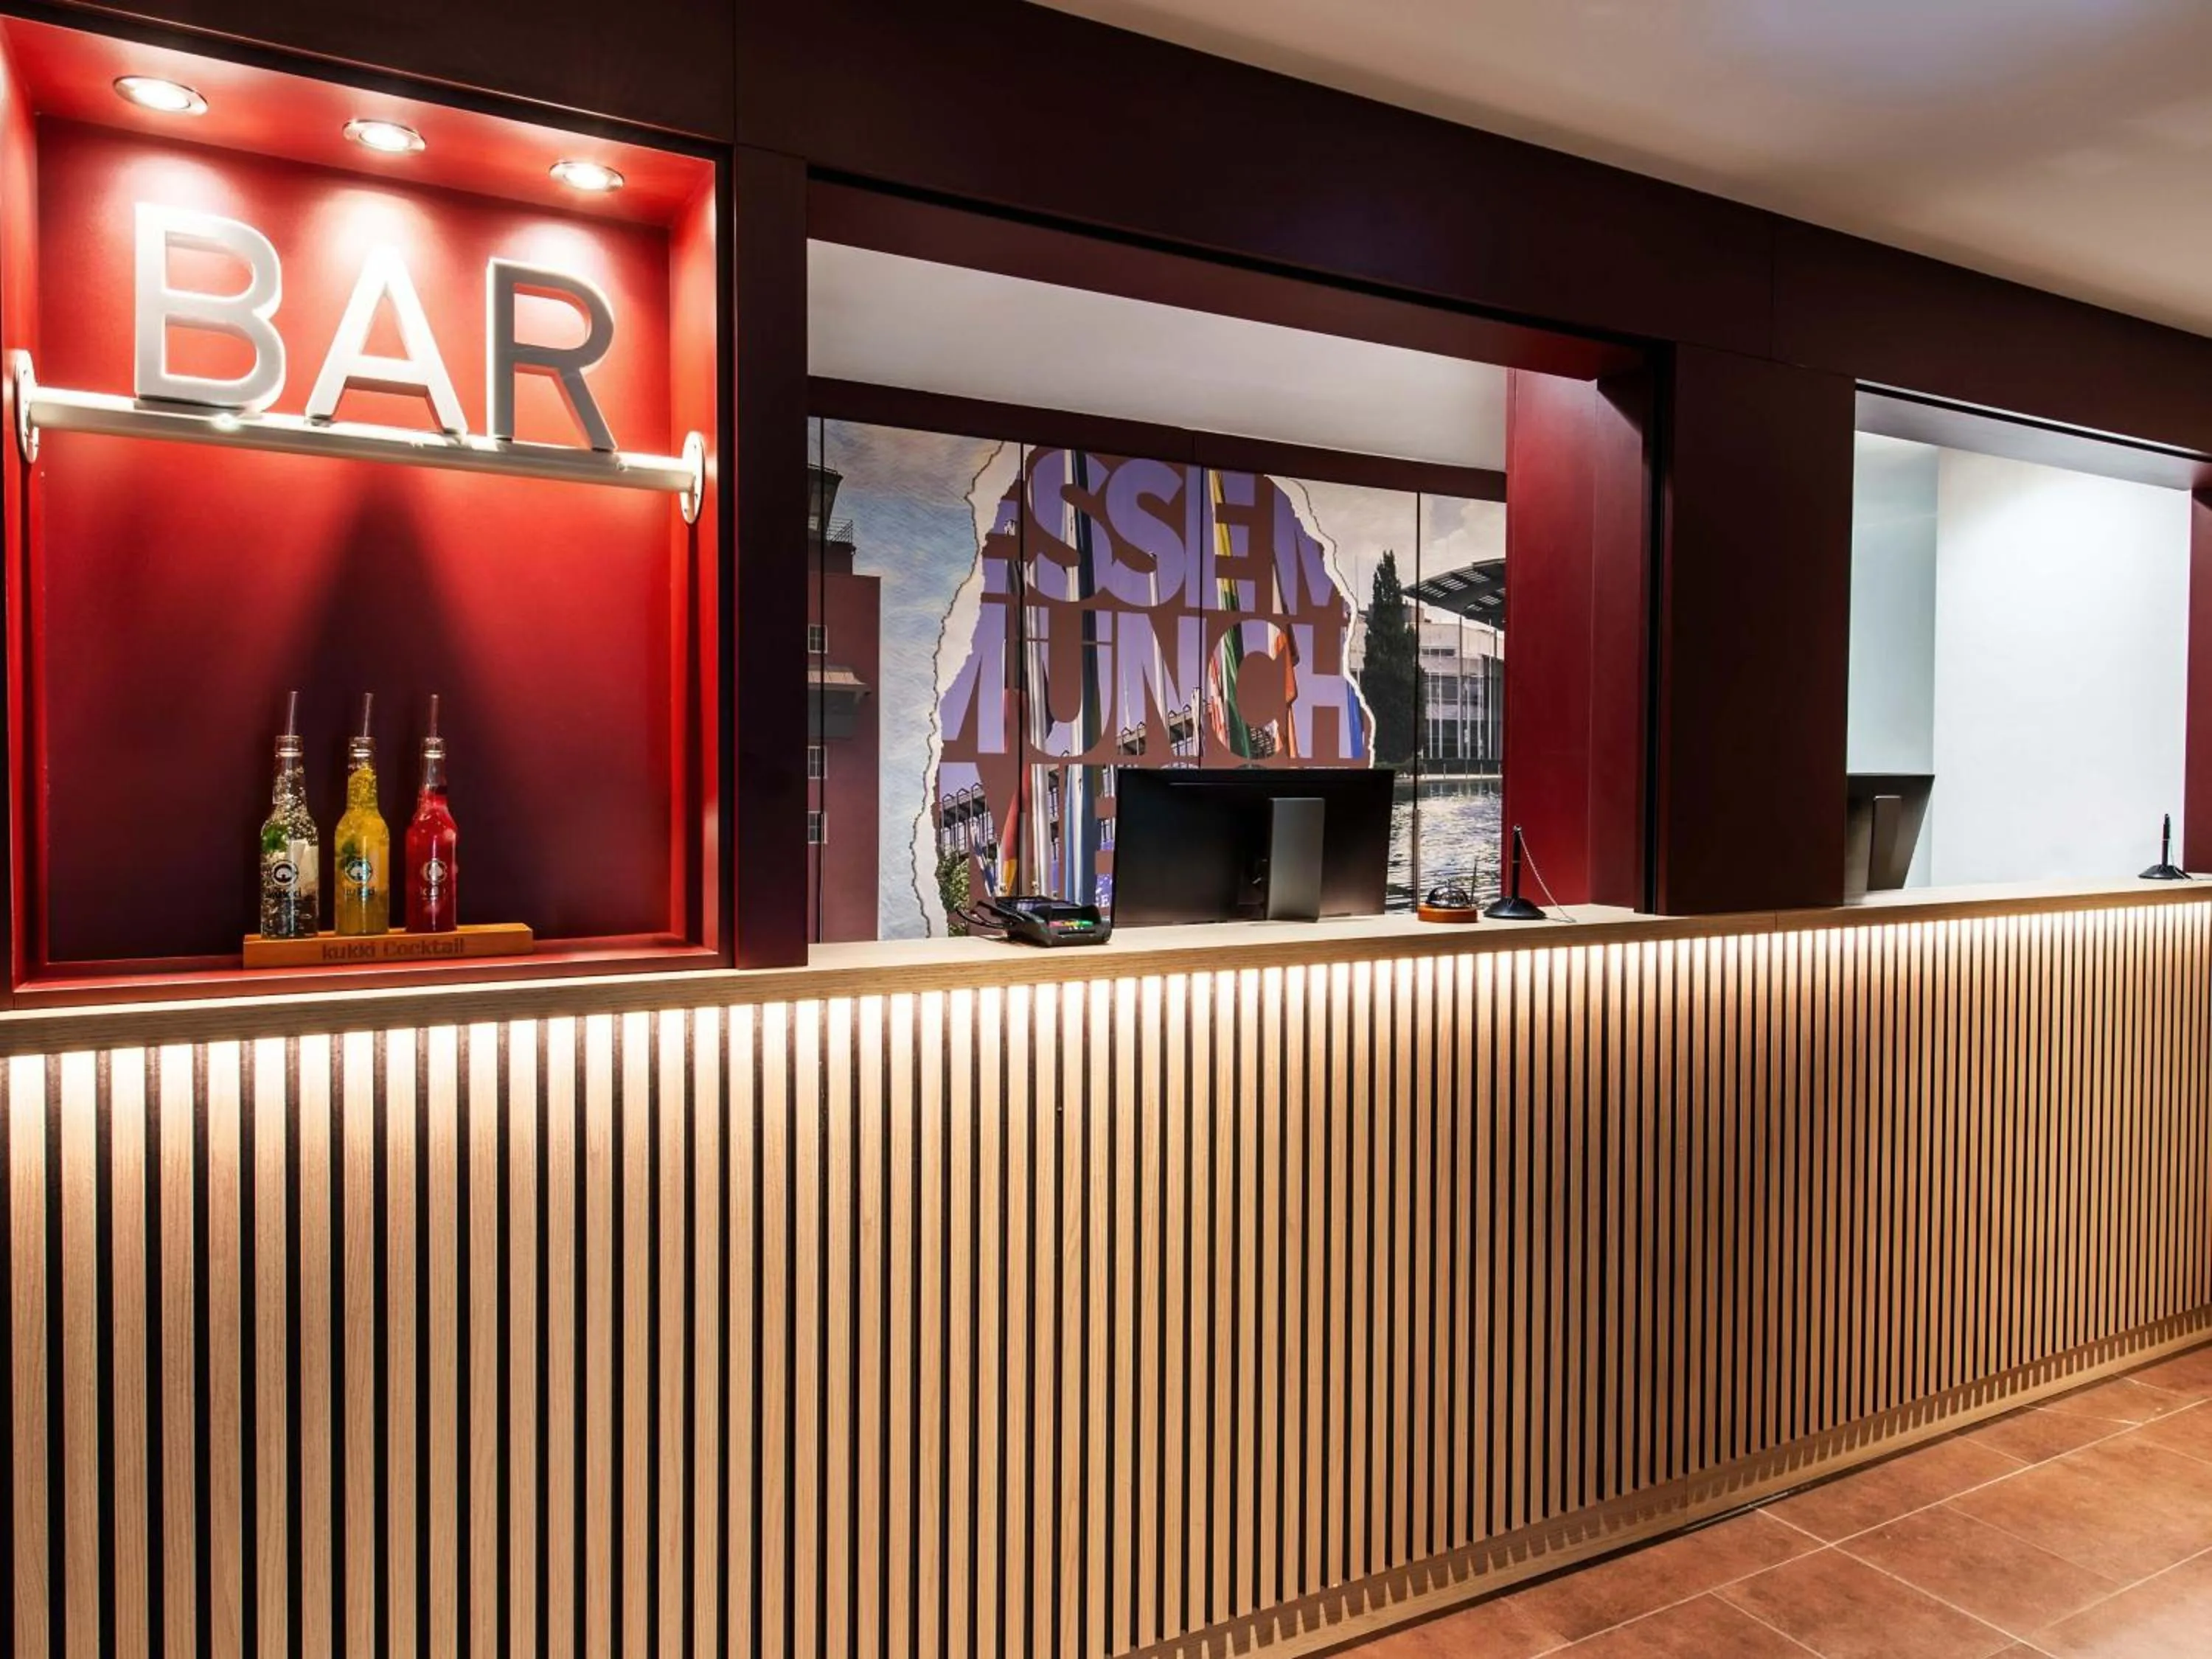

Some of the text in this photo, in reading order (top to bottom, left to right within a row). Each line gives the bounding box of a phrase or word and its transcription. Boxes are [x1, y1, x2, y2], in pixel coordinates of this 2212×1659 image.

[135, 202, 617, 451] BAR
[321, 937, 465, 961] kukki Cocktail
